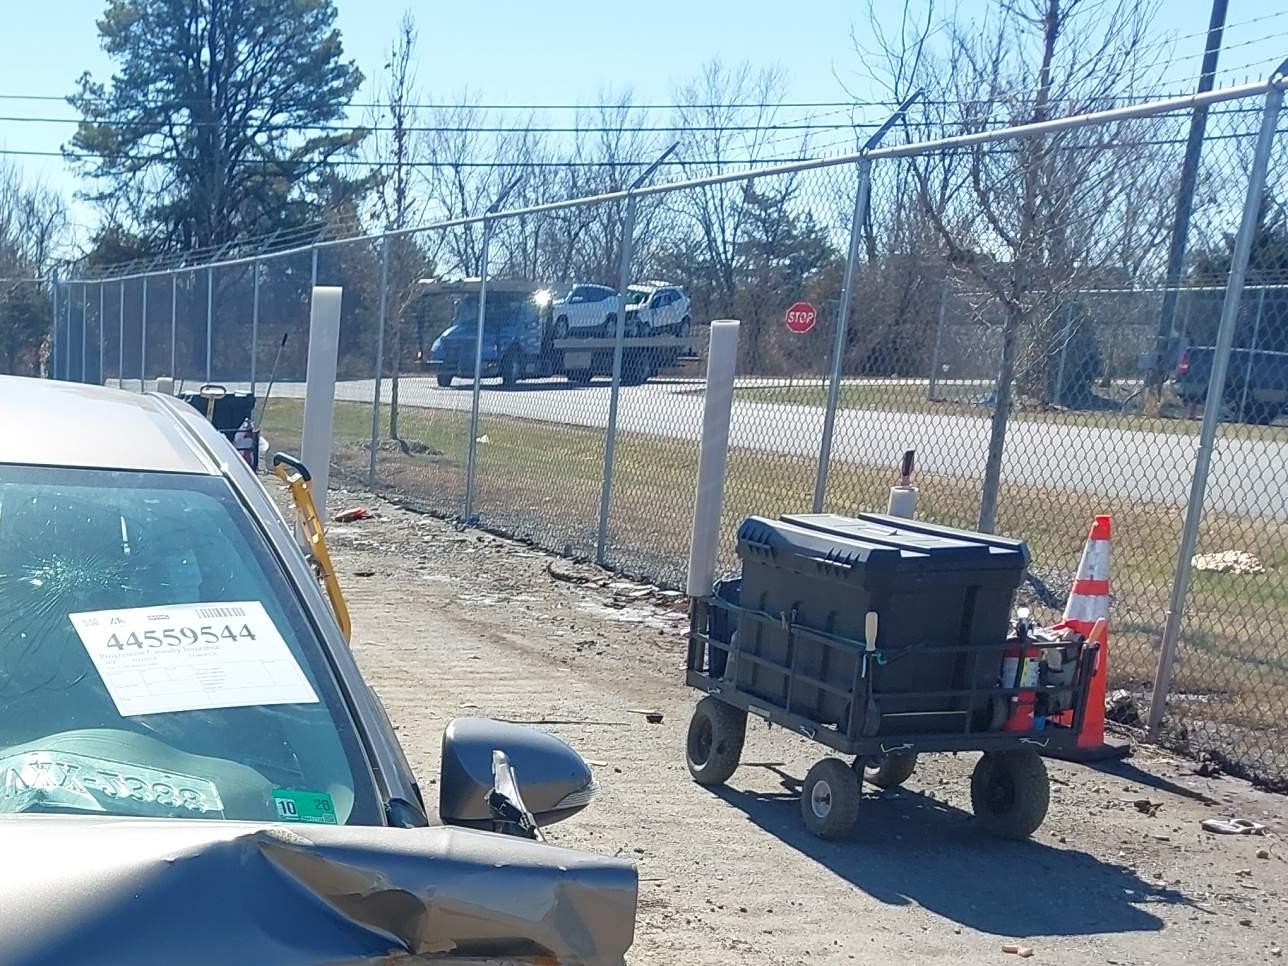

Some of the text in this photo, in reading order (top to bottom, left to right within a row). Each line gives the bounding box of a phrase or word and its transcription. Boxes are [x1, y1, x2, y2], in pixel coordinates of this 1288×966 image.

[787, 311, 814, 324] STOP
[106, 623, 257, 651] 44559544
[278, 800, 297, 815] 10
